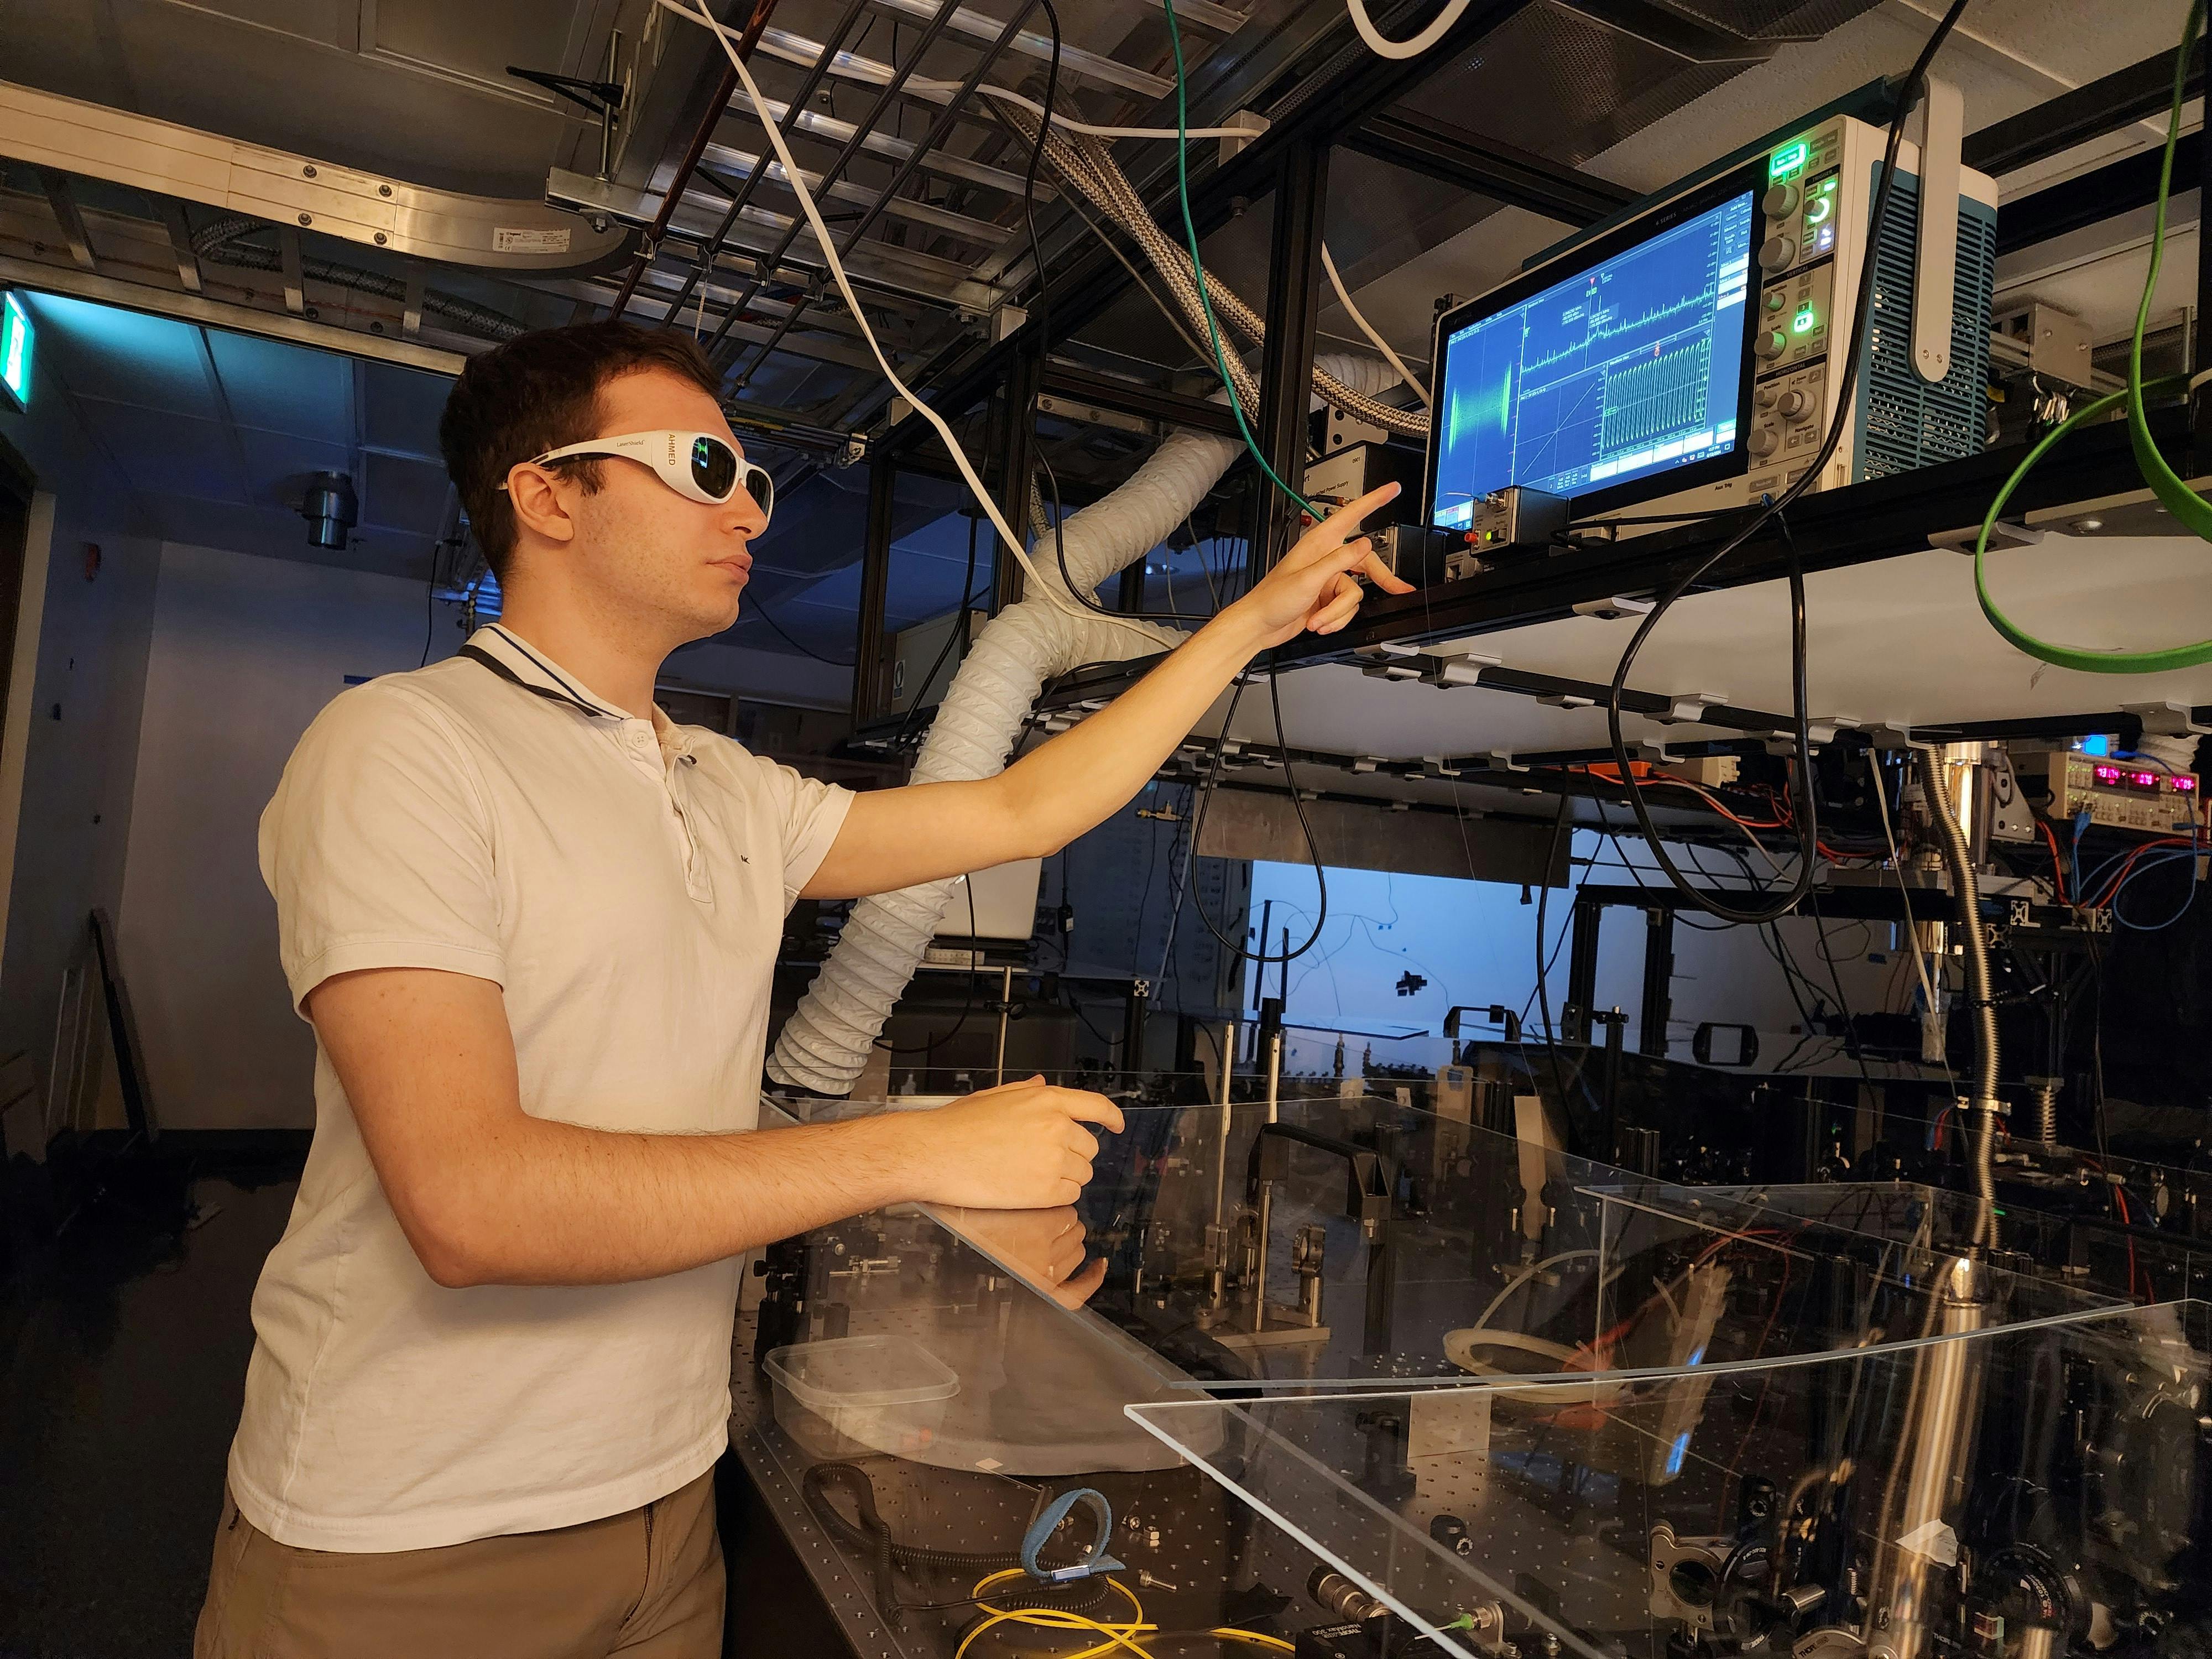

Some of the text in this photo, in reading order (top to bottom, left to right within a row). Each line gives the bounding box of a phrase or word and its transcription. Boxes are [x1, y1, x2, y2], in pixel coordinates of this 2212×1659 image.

[1660, 211, 1677, 225] SERIES
[1787, 265, 1808, 277] VERTICAL
[1776, 363, 1806, 376] HORIZONTAL
[1764, 382, 1780, 390] Position
[1795, 424, 1814, 433] Navigate
[1337, 480, 1349, 489] Supply
[1326, 1623, 1362, 1632] NanoMax
